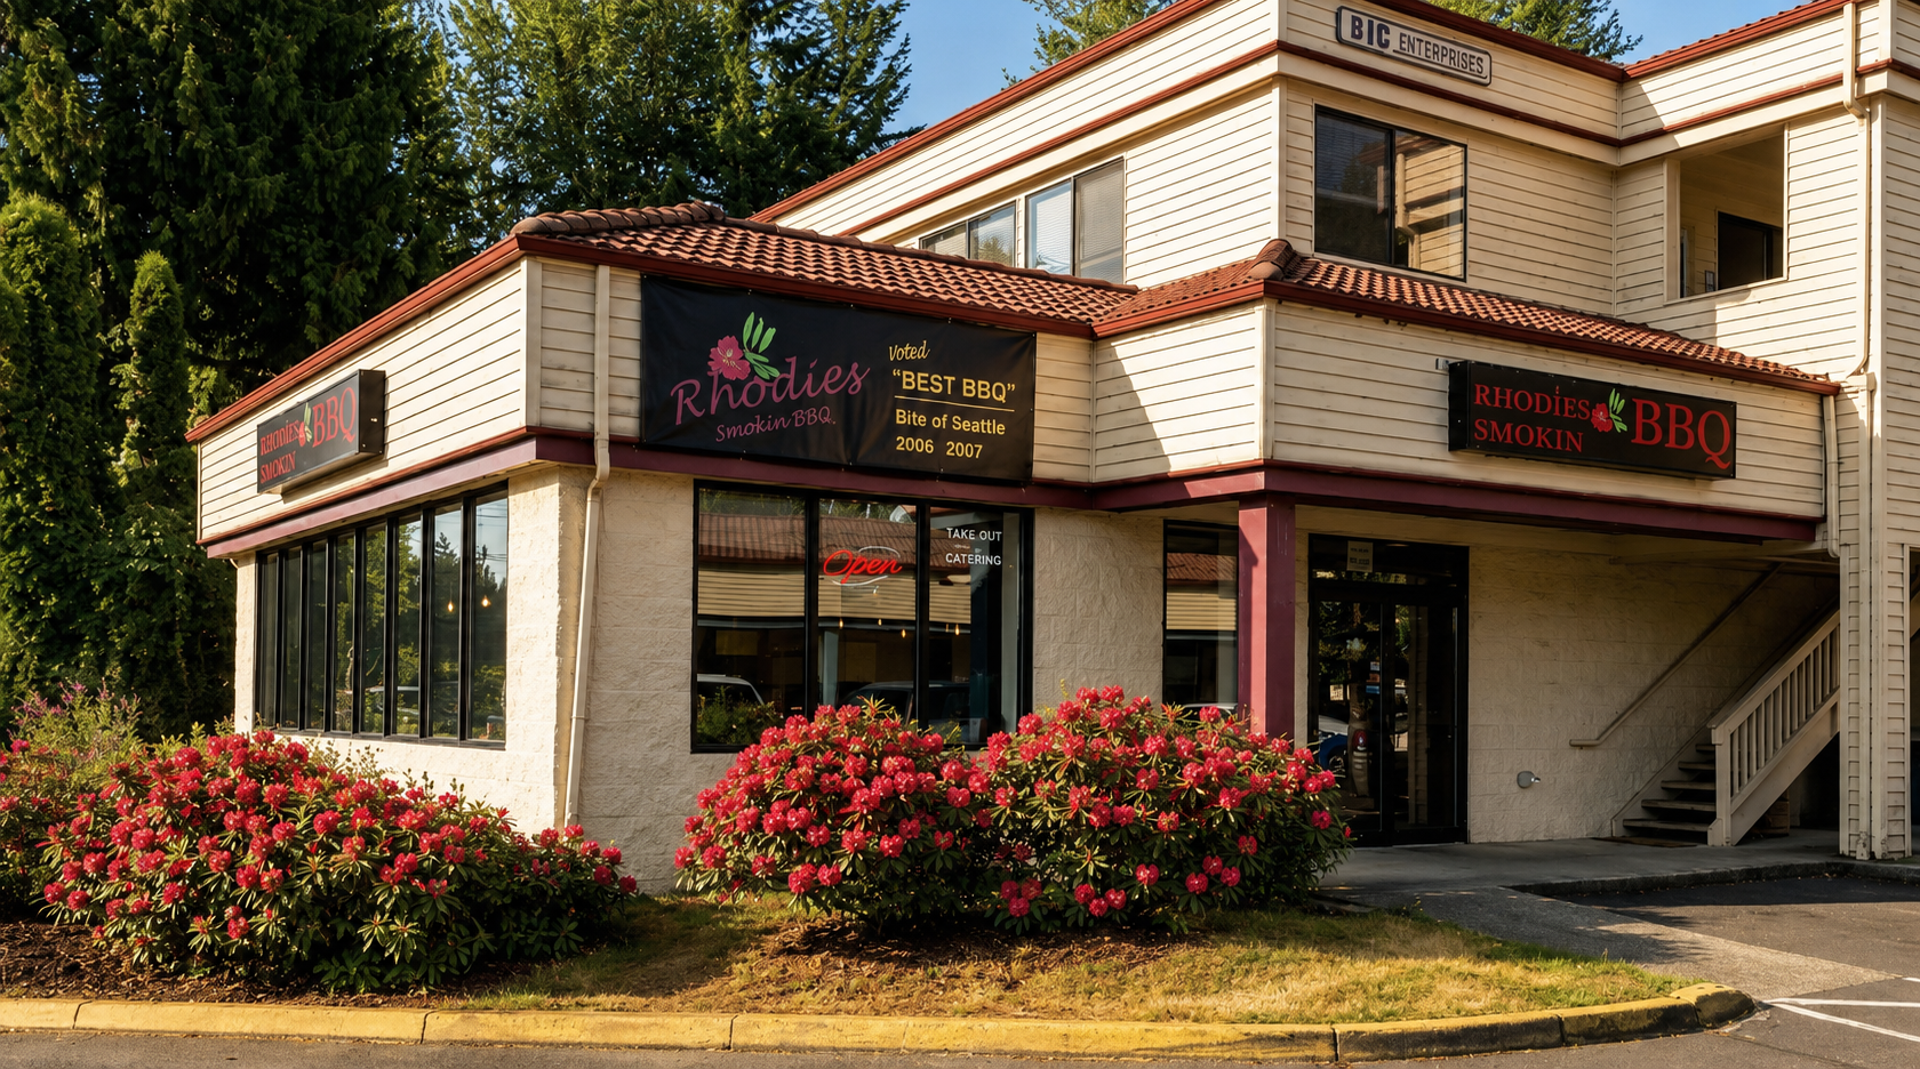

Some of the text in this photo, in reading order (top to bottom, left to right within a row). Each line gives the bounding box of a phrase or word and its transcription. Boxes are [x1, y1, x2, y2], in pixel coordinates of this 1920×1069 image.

[1351, 15, 1483, 74] BIC ENTERPRISES
[889, 340, 931, 362] Voted
[671, 356, 870, 426] Rhodies
[312, 387, 356, 448] BBQ
[715, 417, 789, 443] Smokin
[896, 408, 1006, 435] Bite of Seattle
[896, 436, 984, 459] 2006 2007
[1474, 418, 1584, 453] SMOKIN
[1630, 398, 1731, 470] BBQ
[946, 527, 1002, 542] TAKE OUT
[823, 549, 903, 585] Open
[945, 552, 1002, 566] CATERING
